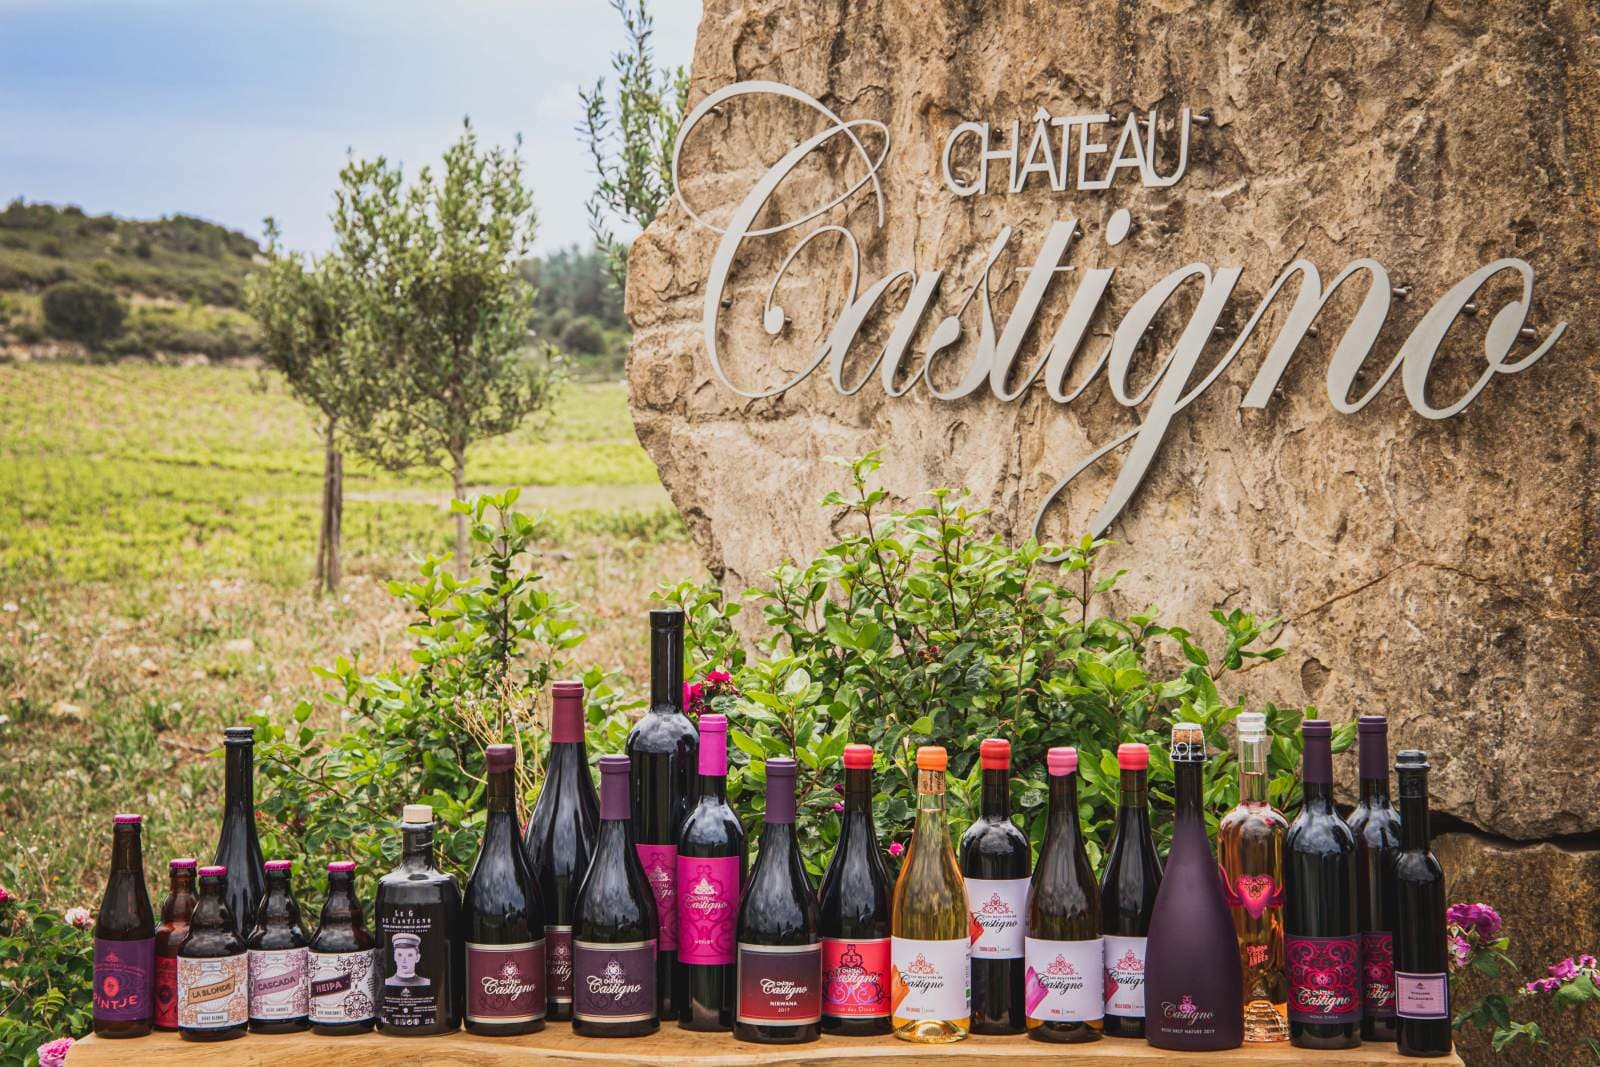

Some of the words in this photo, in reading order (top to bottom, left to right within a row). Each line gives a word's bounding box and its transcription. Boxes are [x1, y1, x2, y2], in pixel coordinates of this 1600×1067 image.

[942, 108, 1193, 196] CHÂTEAU
[672, 80, 1566, 563] Castigno
[973, 911, 1018, 934] Castigno
[192, 990, 202, 999] LA
[202, 983, 232, 997] BLONDE
[257, 976, 296, 990] CASCADA
[316, 981, 342, 993] NEIPA
[481, 976, 536, 1001] Castigno
[586, 975, 642, 1001] Castigno
[760, 978, 808, 1001] Castigno
[899, 971, 944, 994] Castigno
[1037, 972, 1083, 995] Castigno
[1297, 986, 1351, 1013] Castigno
[1160, 1001, 1215, 1026] Castigno
